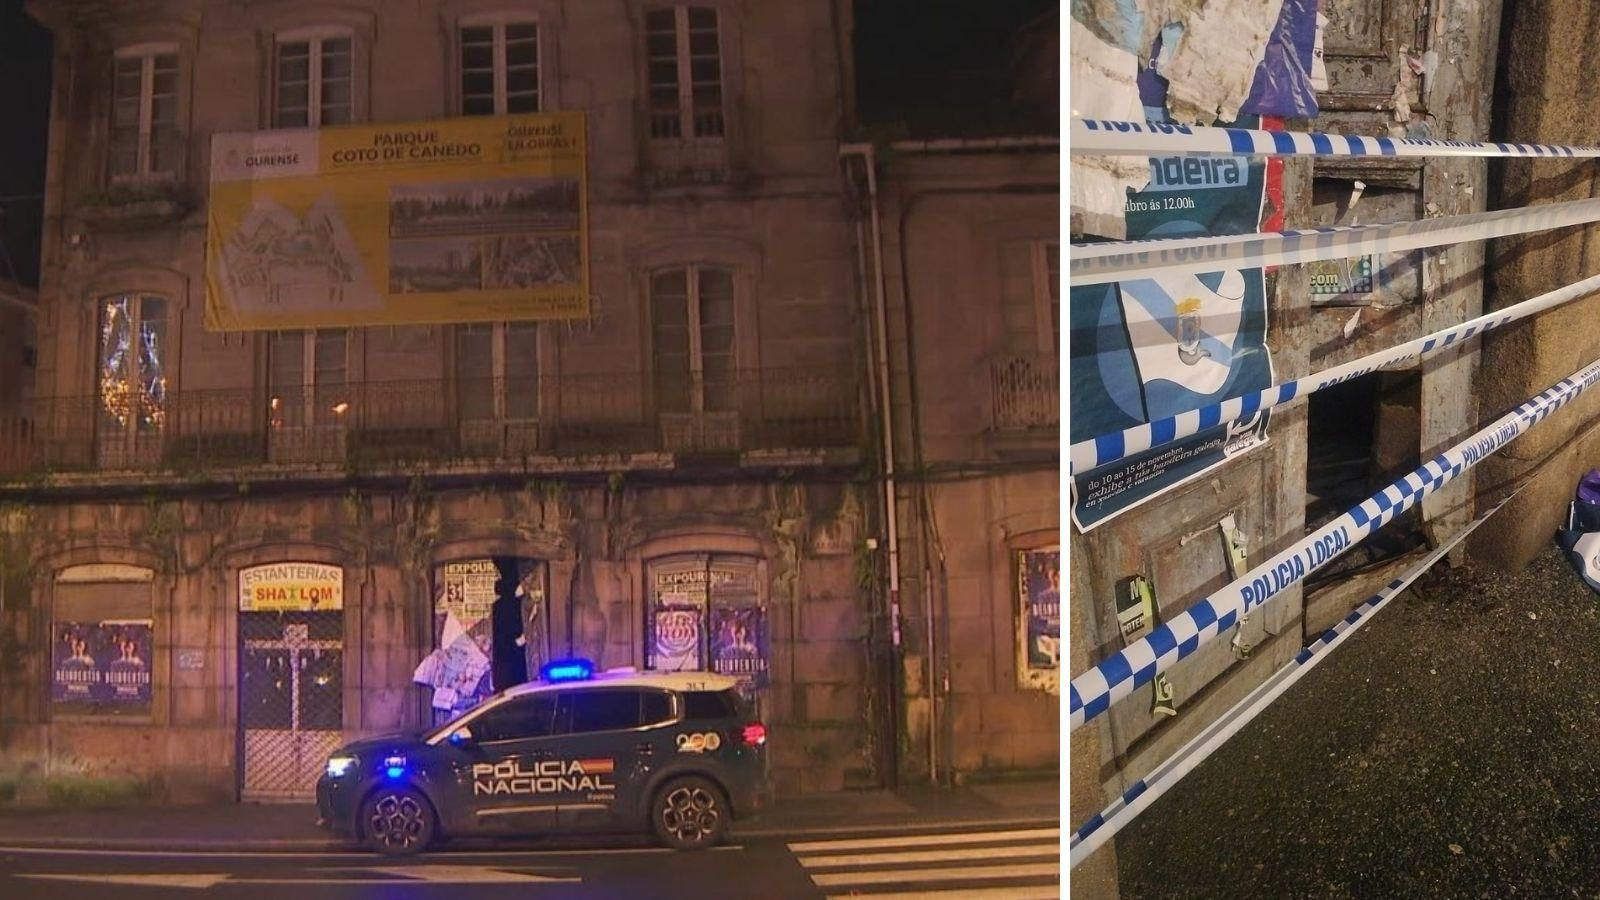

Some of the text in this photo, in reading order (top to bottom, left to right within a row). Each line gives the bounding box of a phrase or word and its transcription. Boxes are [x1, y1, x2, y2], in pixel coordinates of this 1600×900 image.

[374, 131, 438, 146] PARQUE
[245, 153, 299, 167] OURENSE
[332, 143, 480, 162] COTO DE CANEDO
[1163, 196, 1195, 210] 12.00h
[1461, 434, 1496, 469] POLICIA
[1087, 479, 1125, 501] exhibe
[1153, 448, 1193, 472] bandeira
[1088, 480, 1100, 491] do
[1102, 474, 1113, 486] 10
[1125, 464, 1136, 476] 15
[1136, 460, 1147, 471] de
[1147, 447, 1183, 467] novembro
[1240, 525, 1352, 614] POLICIA LOCAL
[449, 584, 463, 600] 31
[473, 760, 585, 779] POLICIA
[474, 775, 616, 796] NACIONAL
